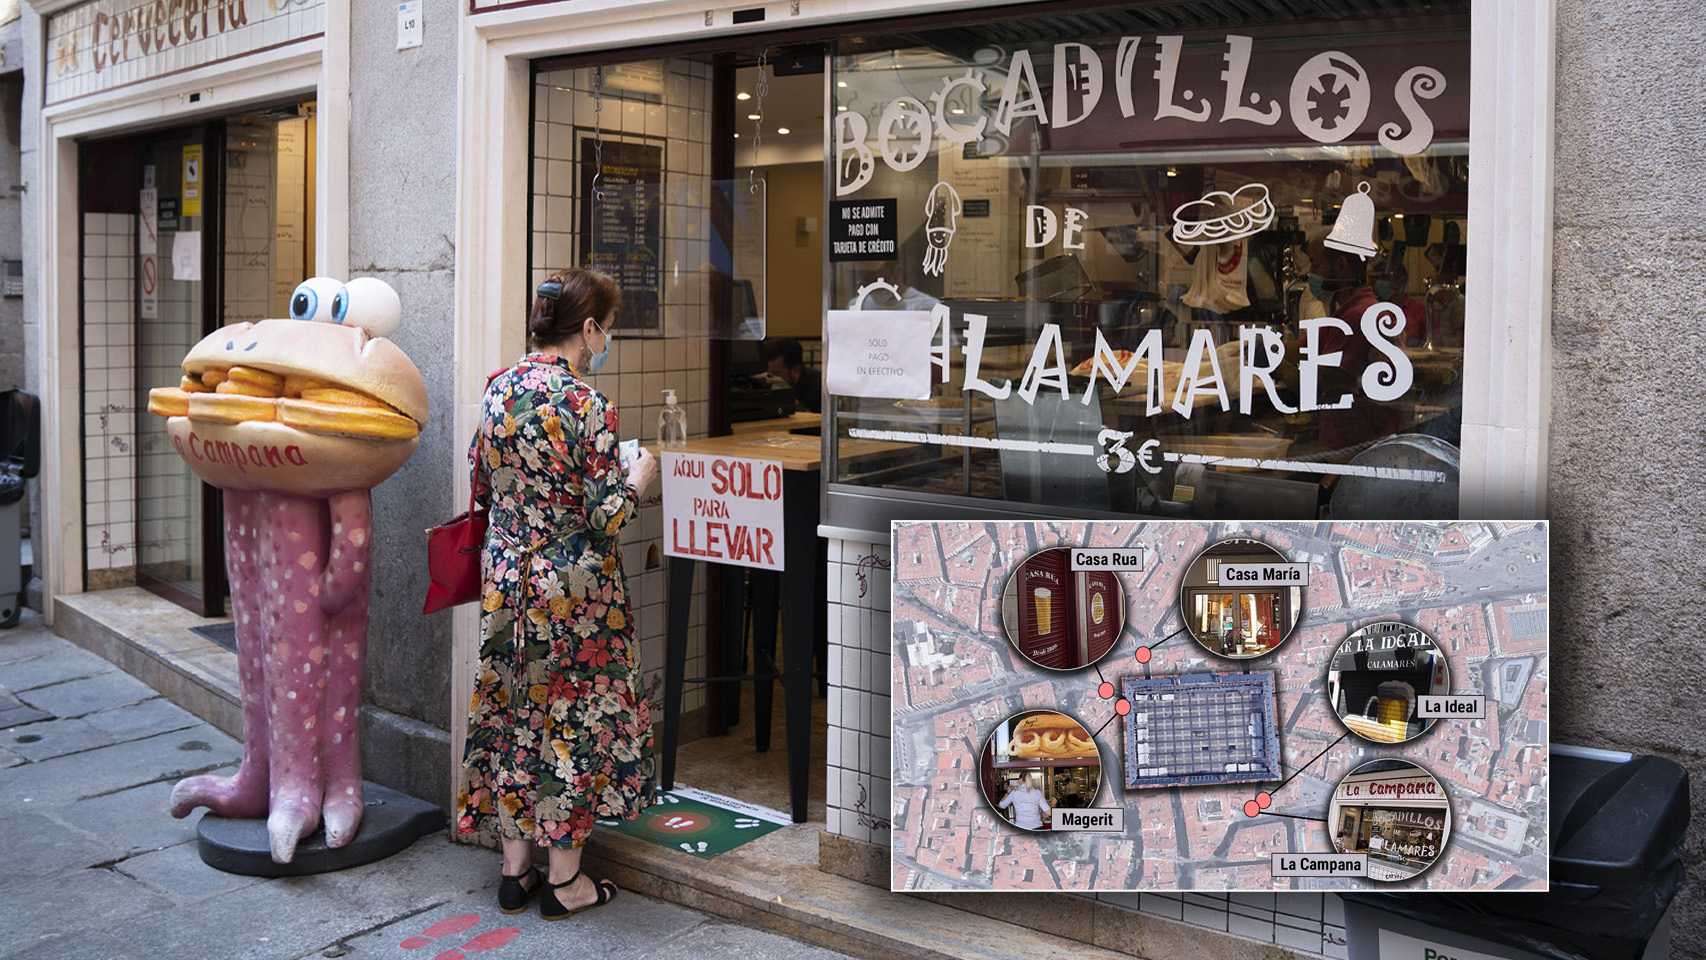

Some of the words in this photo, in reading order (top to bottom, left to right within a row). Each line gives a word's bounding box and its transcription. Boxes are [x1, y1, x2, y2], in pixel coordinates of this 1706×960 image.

[835, 34, 1447, 197] BOCADILLOS
[841, 207, 851, 219] NO
[852, 206, 860, 219] SE
[861, 205, 885, 218] ADMITE
[848, 223, 864, 236] PAGO
[865, 223, 879, 236] CON
[1025, 204, 1090, 250] DE
[833, 241, 858, 254] TARJETA
[858, 240, 867, 253] DE
[867, 238, 895, 253] CRÉDITO
[869, 339, 888, 348] SOLO
[868, 353, 890, 361] PAGO
[856, 366, 867, 375] EN
[868, 367, 904, 376] EFECTIVO
[173, 434, 187, 457] a
[189, 431, 308, 474] Campana
[1096, 427, 1163, 474] 3€
[673, 458, 705, 479] AQUI
[711, 458, 782, 501] SOLO
[693, 497, 730, 519] PARA
[672, 517, 775, 566] LLEVAR
[1337, 641, 1352, 653] AR
[1356, 637, 1375, 653] LA
[1380, 631, 1431, 650] IDEAL
[1366, 659, 1416, 669] CALAMARES
[1346, 784, 1360, 797] La
[1369, 781, 1436, 799] Campana
